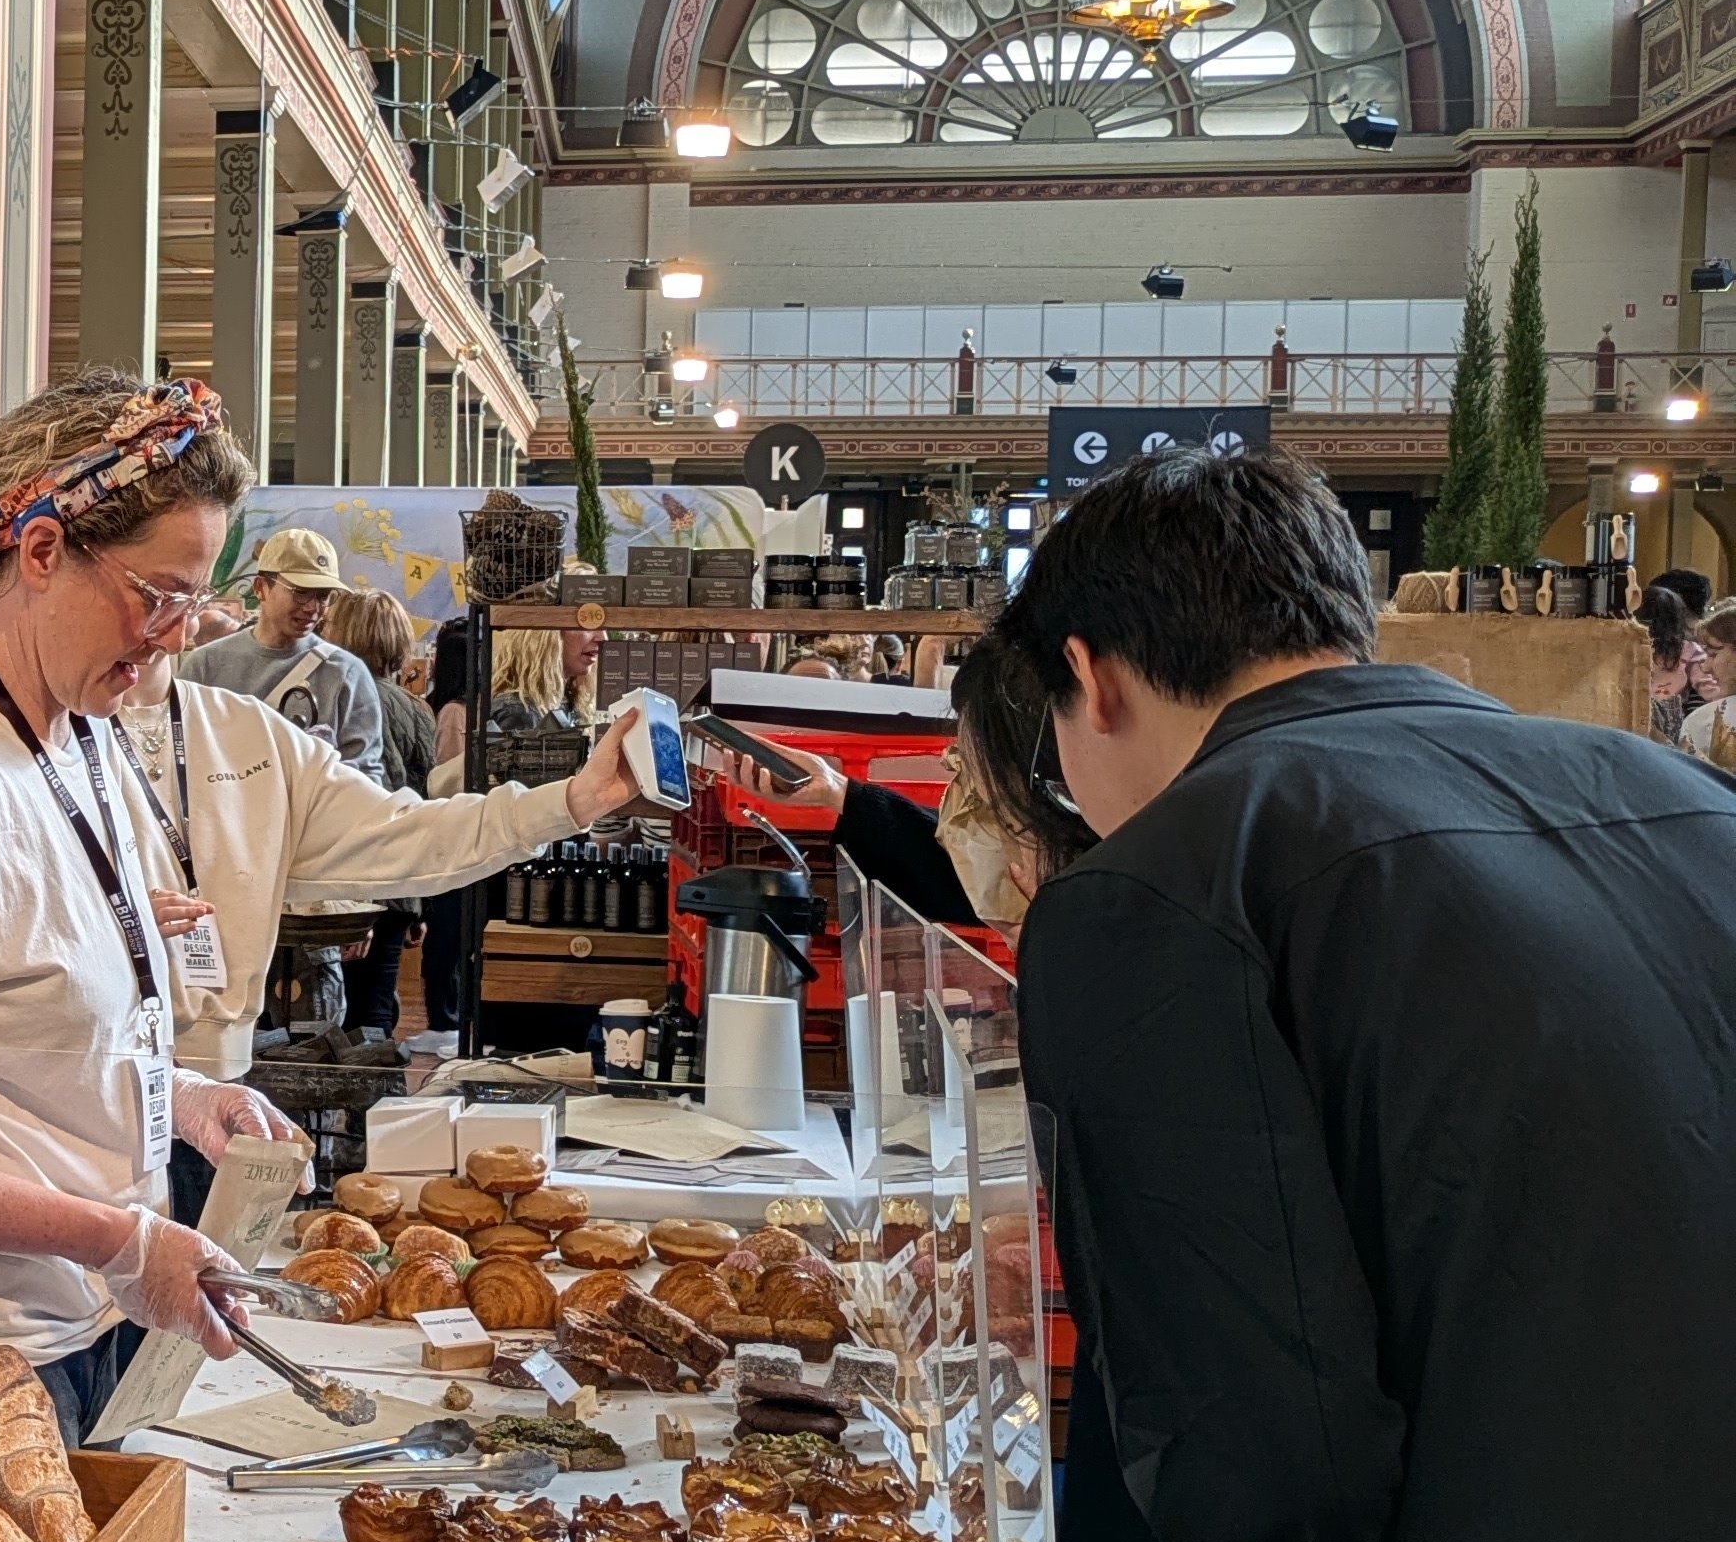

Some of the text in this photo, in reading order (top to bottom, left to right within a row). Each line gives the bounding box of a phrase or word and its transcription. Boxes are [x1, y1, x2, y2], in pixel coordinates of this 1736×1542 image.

[770, 445, 801, 482] K
[43, 764, 62, 789] BIG
[91, 765, 105, 789] BIG
[206, 759, 272, 783] COBB LANE
[115, 904, 136, 930] BIG
[193, 928, 211, 942] BIG
[184, 943, 214, 954] DESIGN
[185, 958, 216, 967] MARKET
